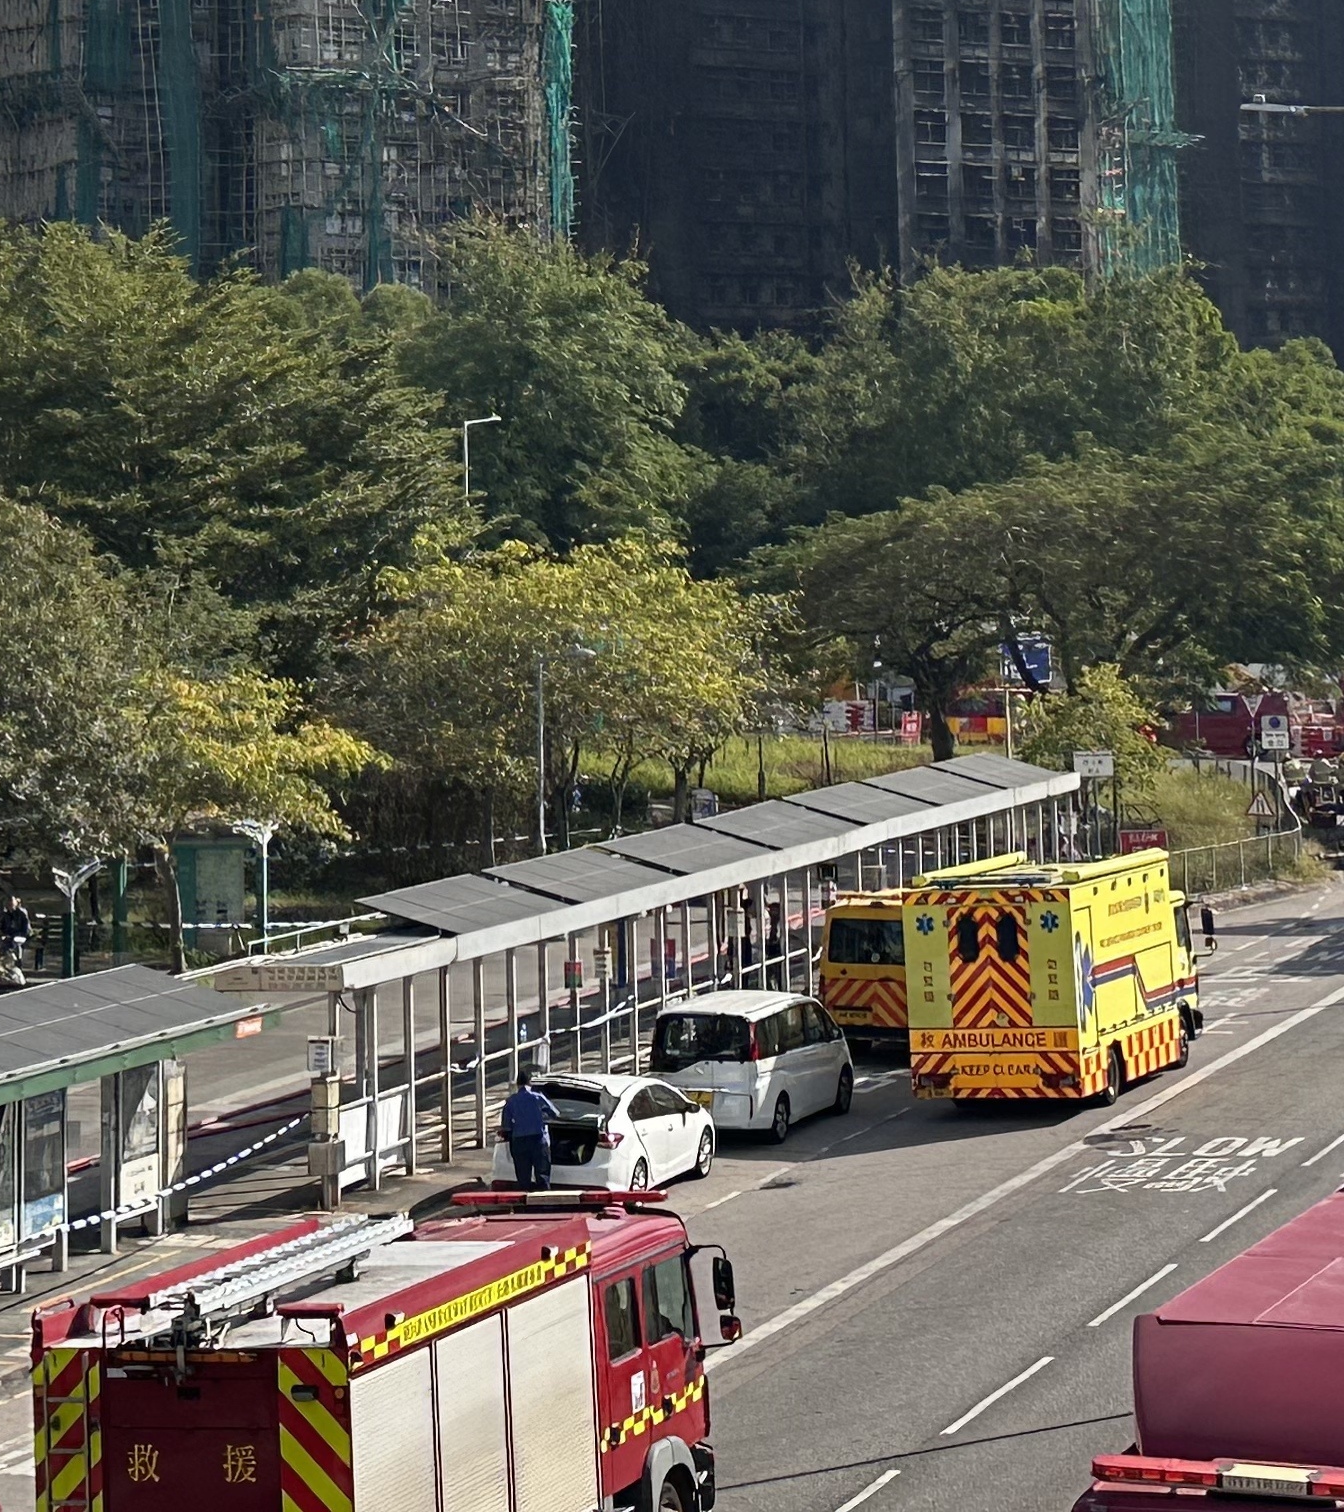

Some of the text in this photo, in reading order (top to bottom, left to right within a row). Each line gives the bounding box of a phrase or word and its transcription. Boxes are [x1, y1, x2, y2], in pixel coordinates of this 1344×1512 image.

[941, 1031, 1047, 1049] AMBULANCE
[959, 1063, 1030, 1076] KEEP CLEAR
[1058, 1157, 1258, 1194] 慢駛
[127, 1444, 257, 1483] 救援
